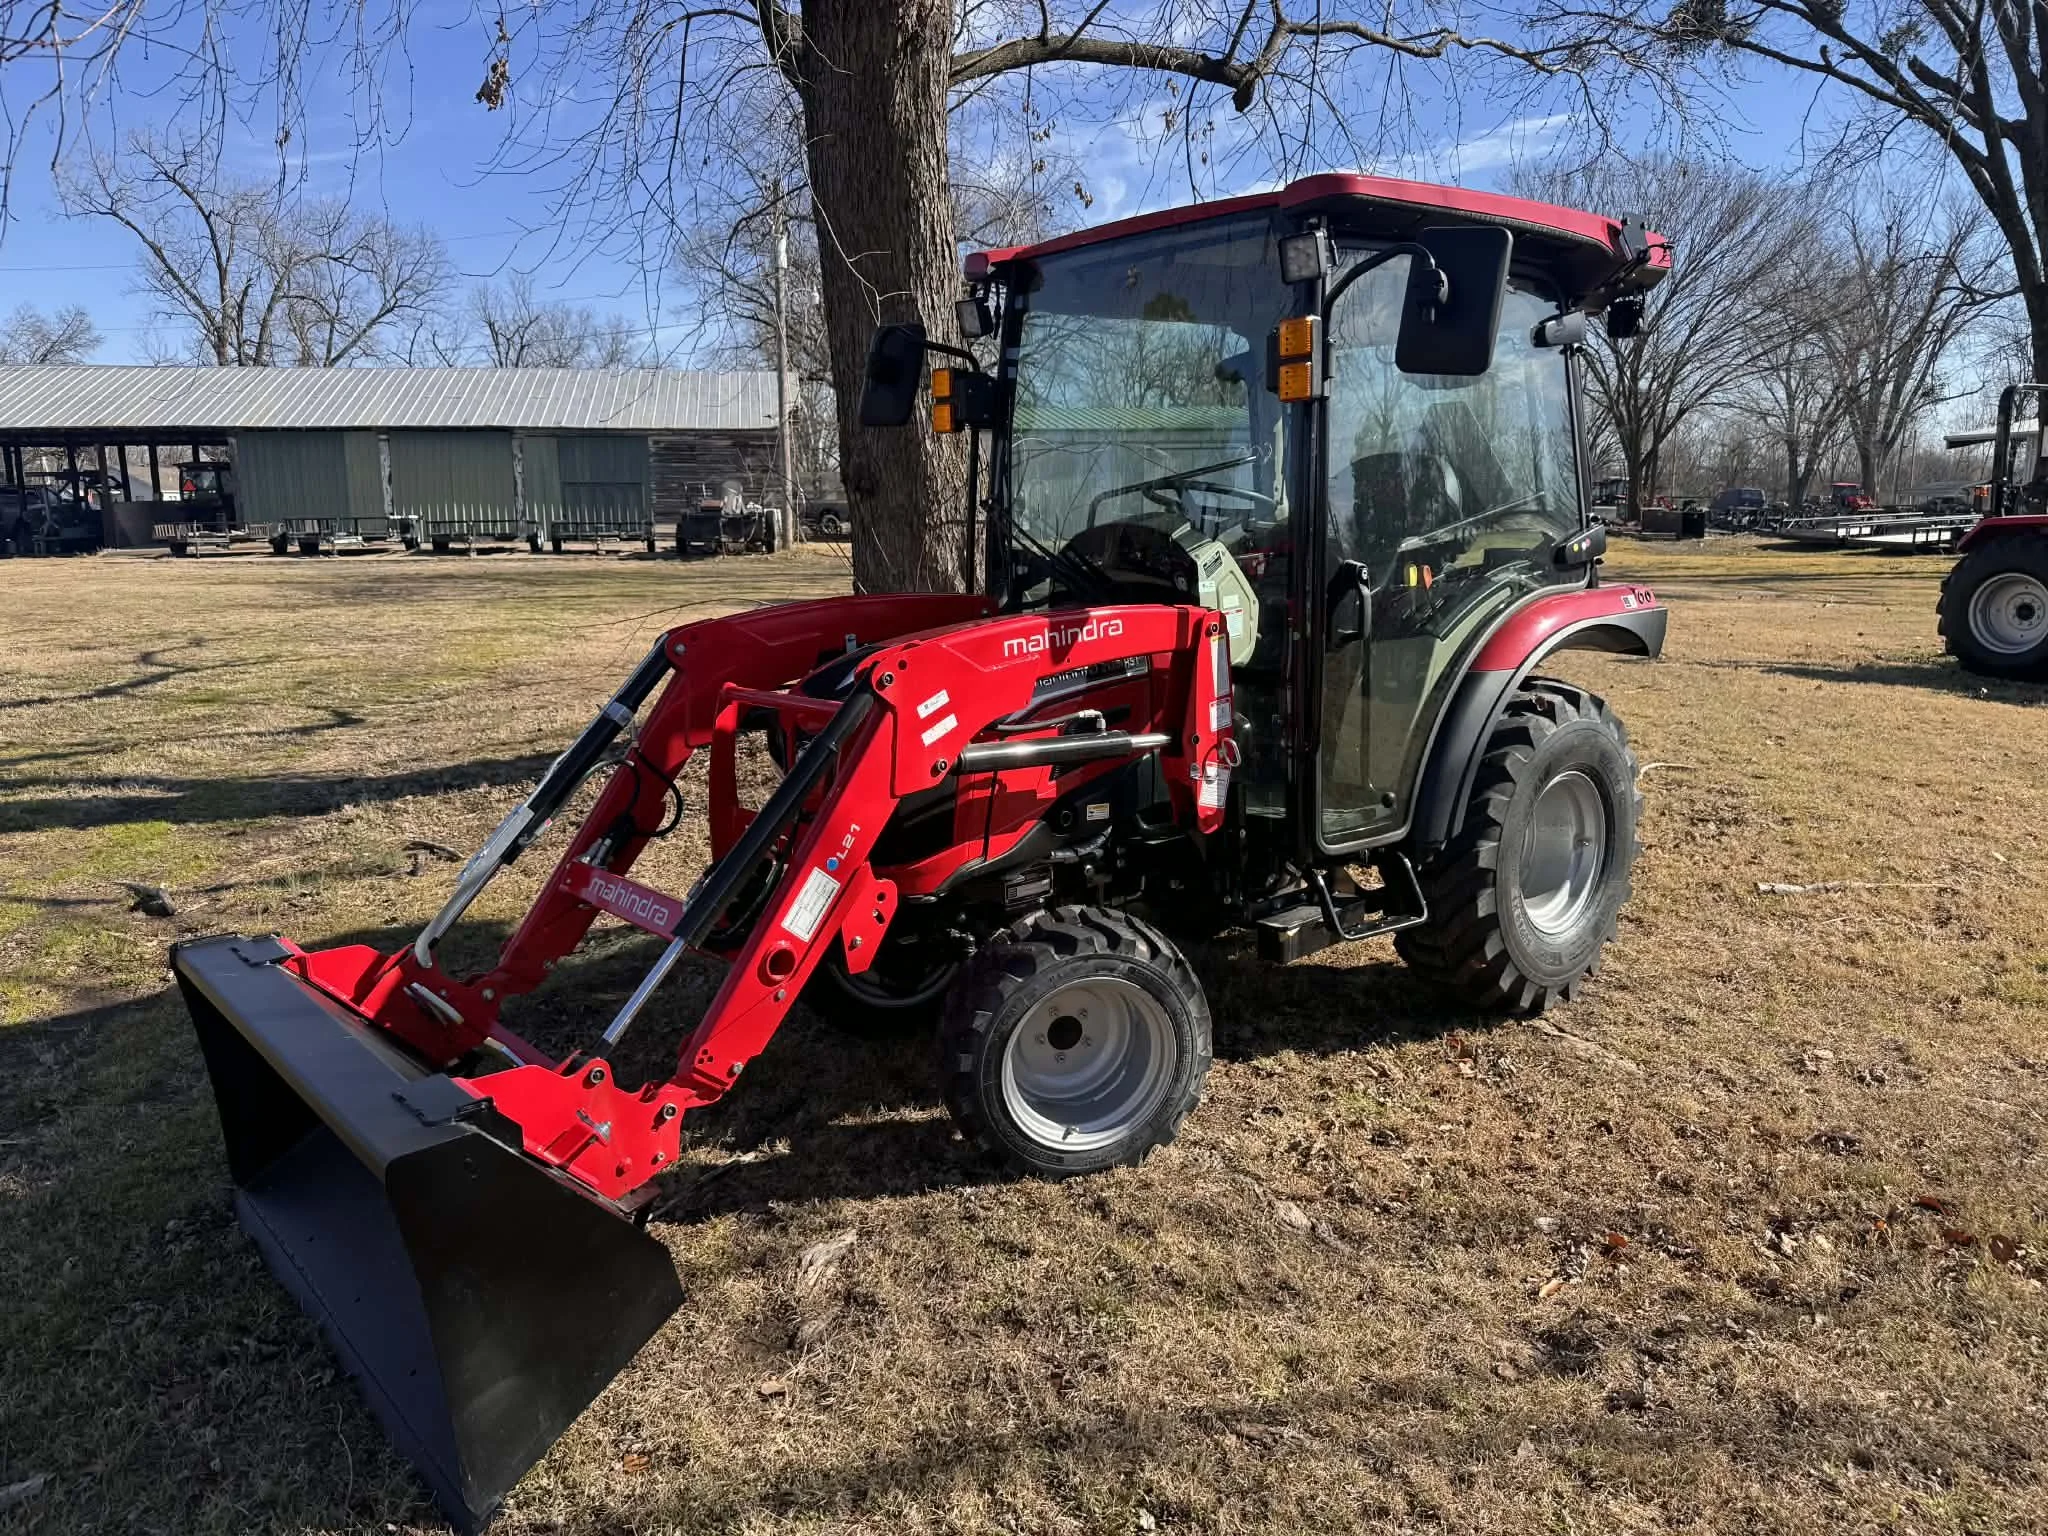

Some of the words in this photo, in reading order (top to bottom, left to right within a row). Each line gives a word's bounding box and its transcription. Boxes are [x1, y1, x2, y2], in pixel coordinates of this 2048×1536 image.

[1003, 618, 1123, 657] mahindra
[836, 823, 861, 860] L21
[588, 877, 669, 926] mahindra
